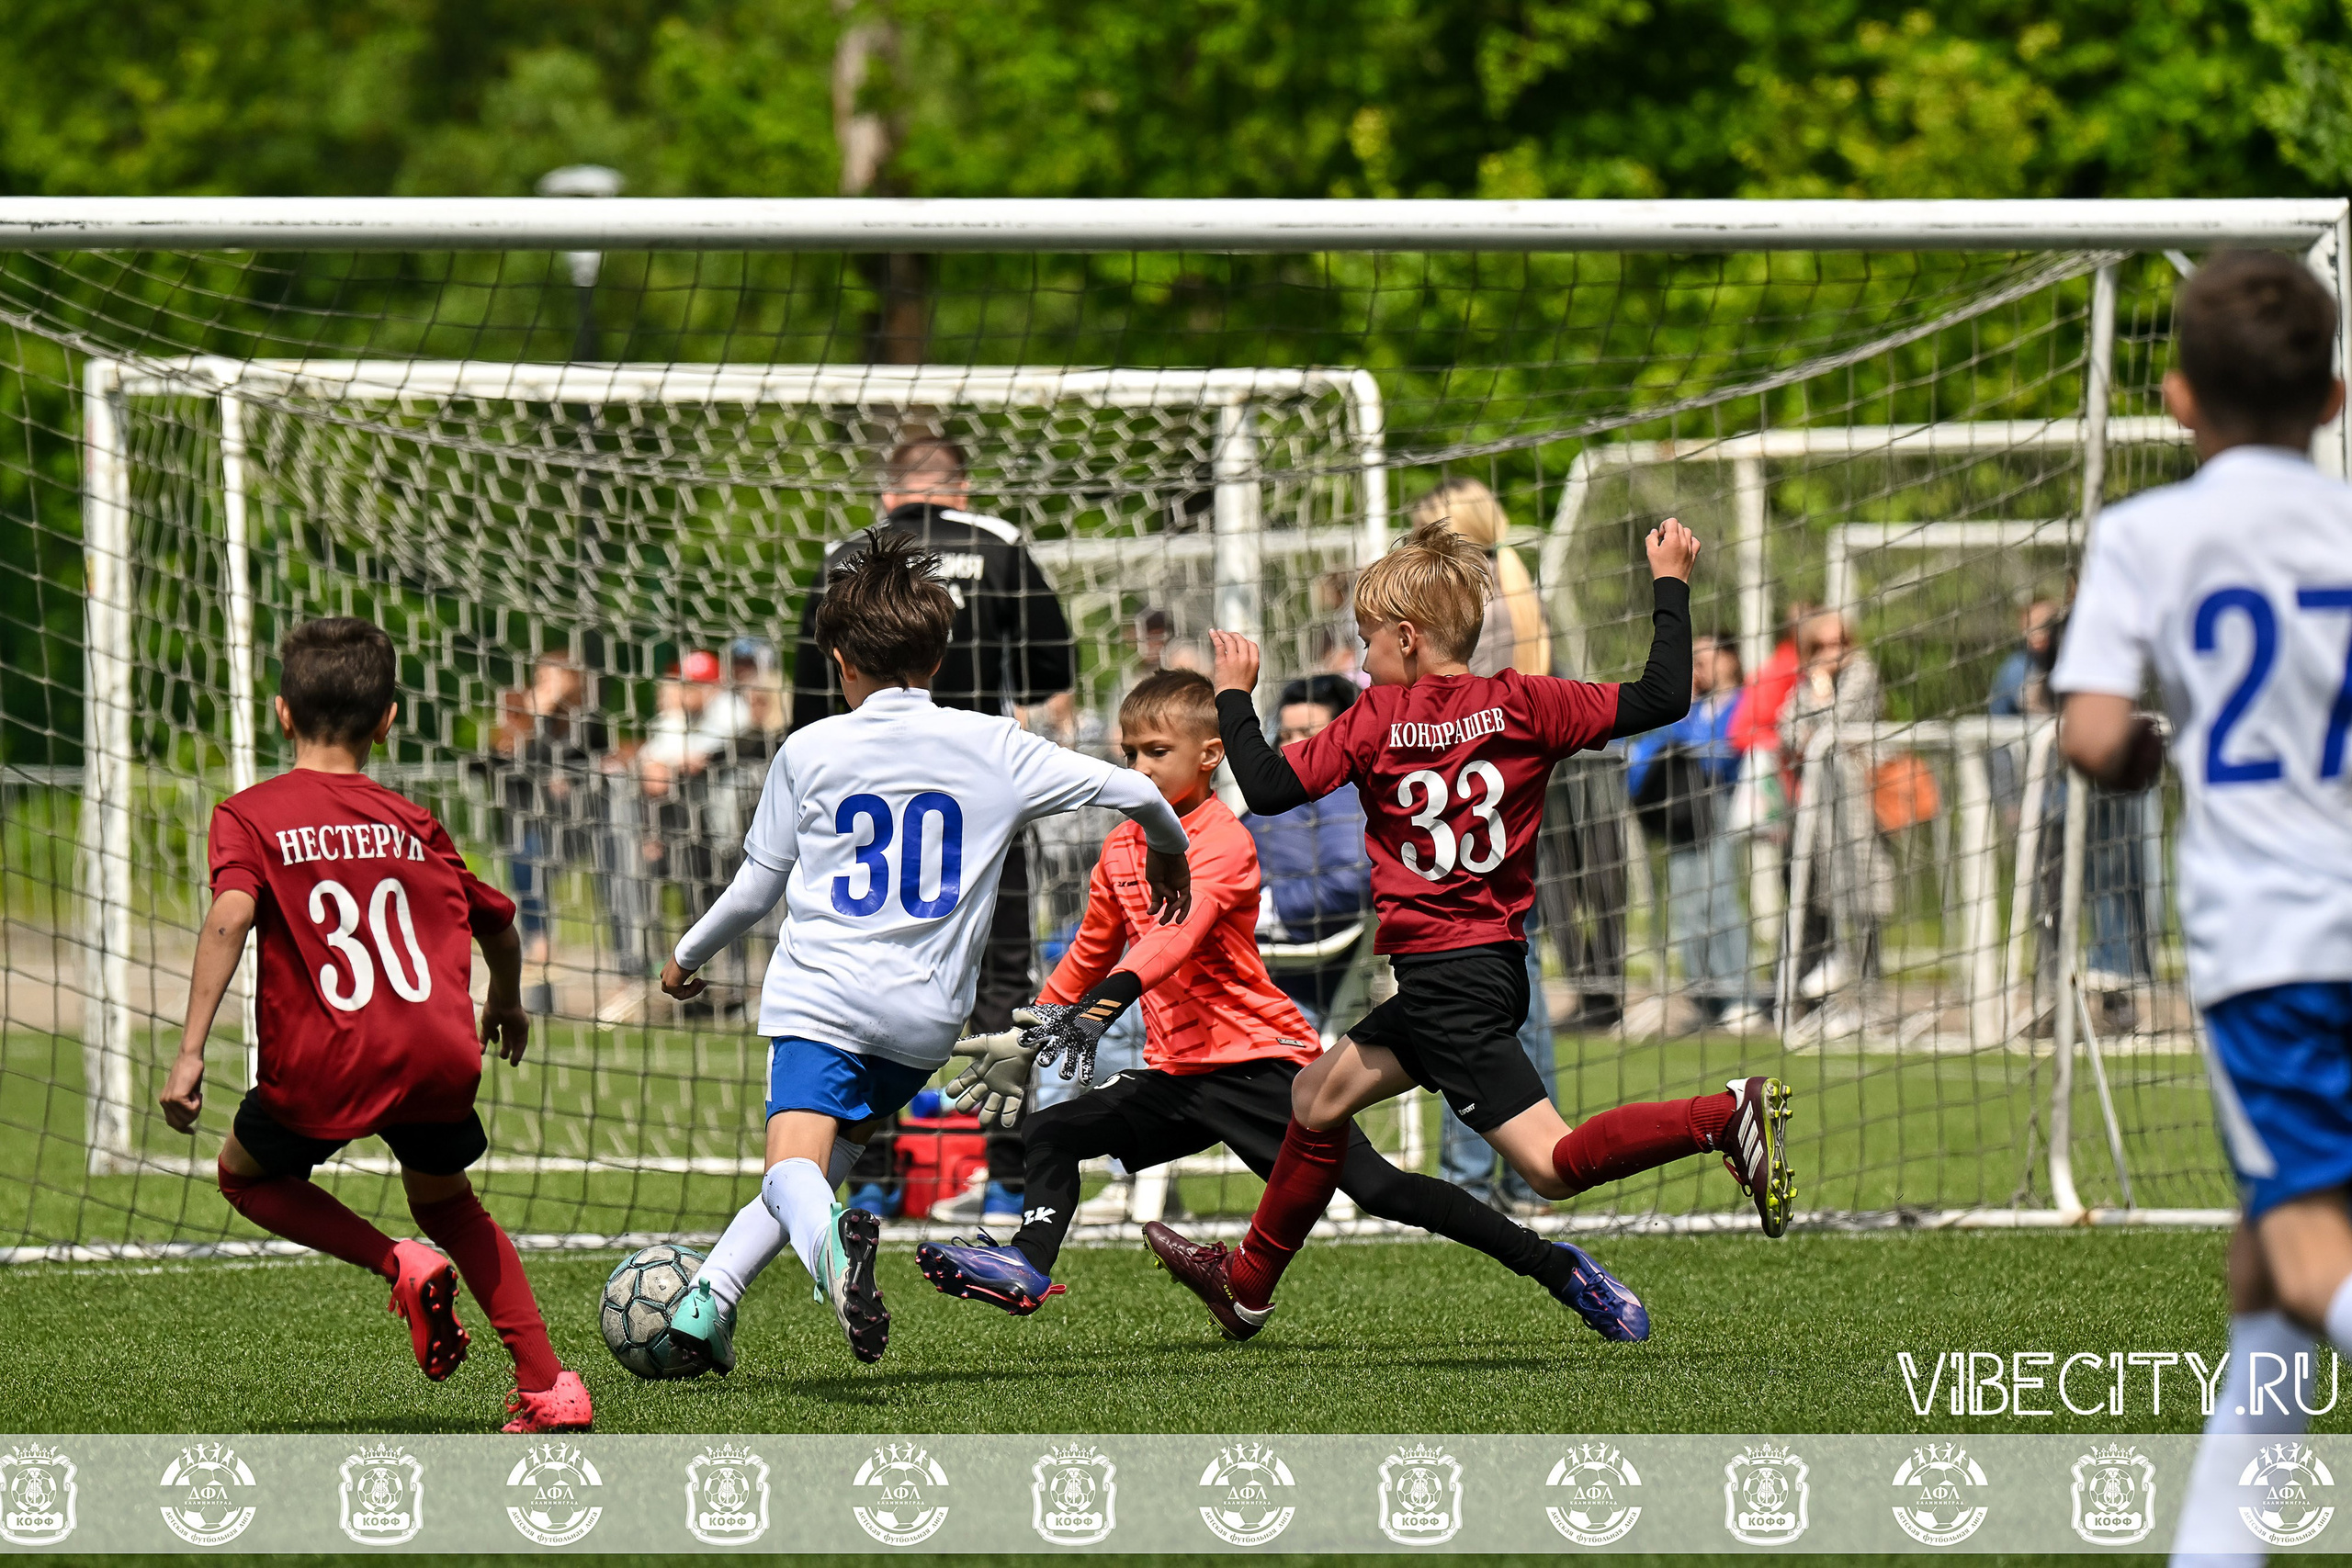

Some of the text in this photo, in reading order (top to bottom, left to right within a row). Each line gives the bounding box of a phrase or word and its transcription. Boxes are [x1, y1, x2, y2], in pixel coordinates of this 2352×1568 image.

[1388, 706, 1506, 752] КОНДРАШЕВ
[2193, 587, 2352, 784] 27
[831, 791, 963, 919] 30
[1397, 760, 1507, 881] 33
[308, 877, 432, 1012] 30
